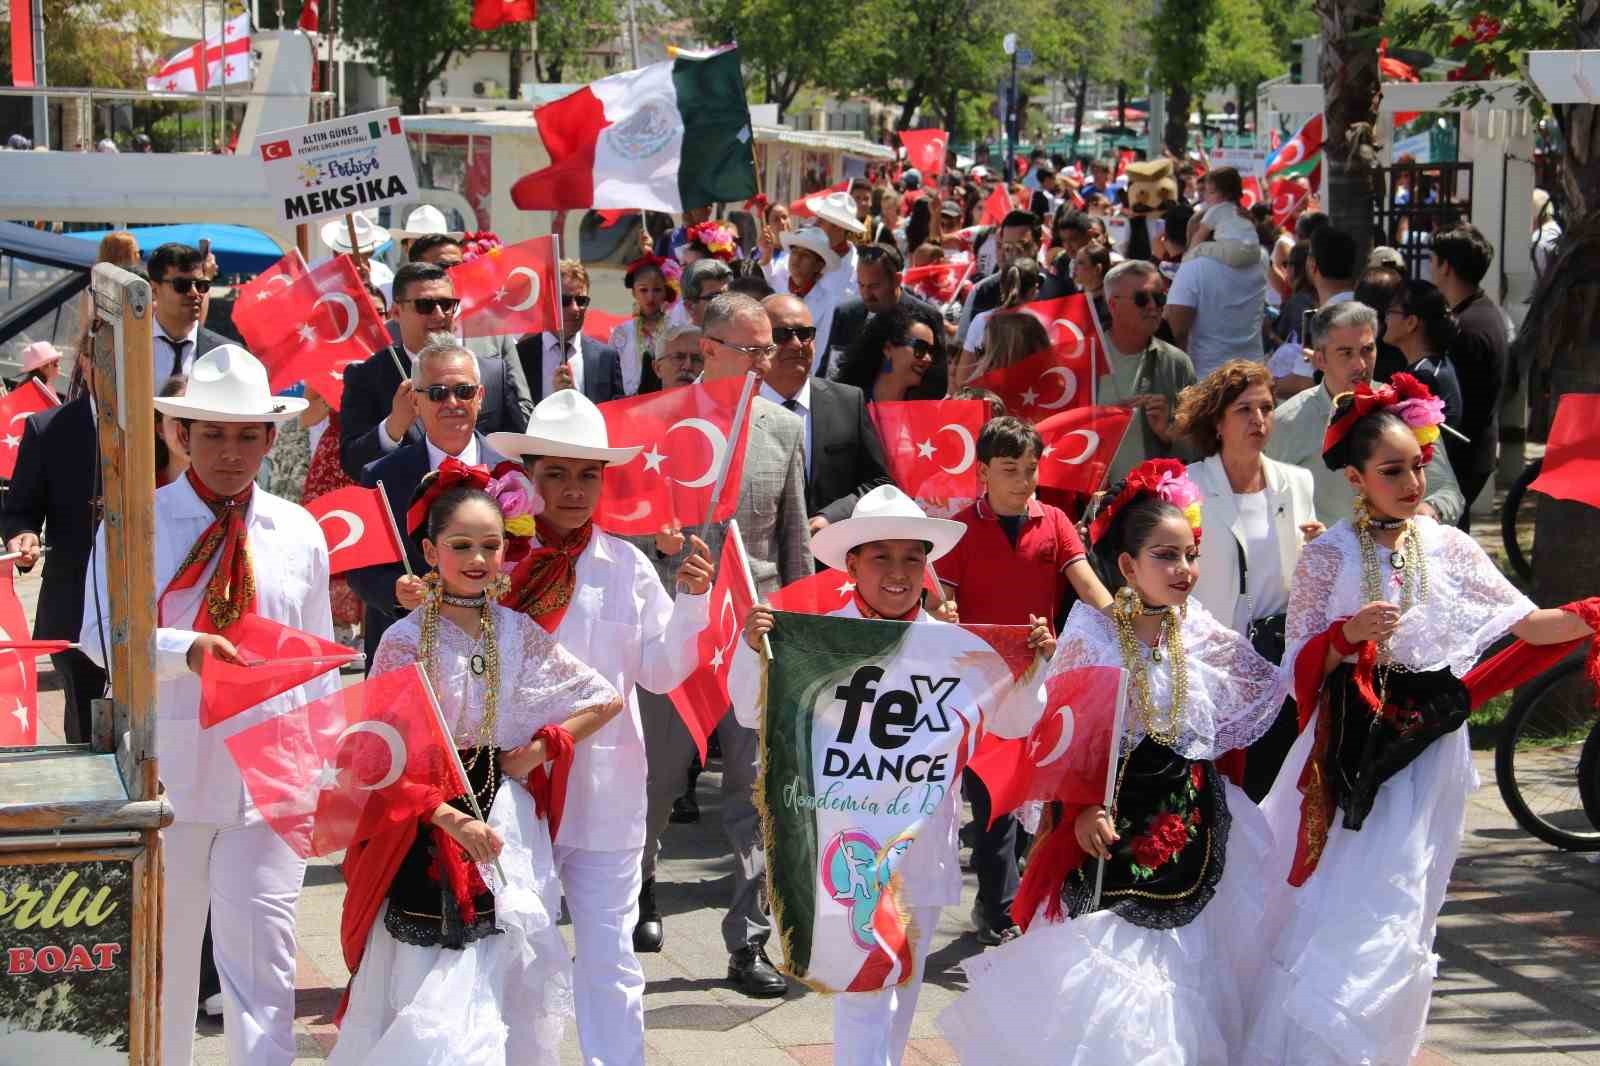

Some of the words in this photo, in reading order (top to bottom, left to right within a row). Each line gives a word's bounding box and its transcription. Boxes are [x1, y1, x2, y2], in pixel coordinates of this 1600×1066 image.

[284, 175, 408, 220] MEKSİKA
[822, 747, 949, 783] DANCE
[886, 785, 914, 815] de
[7, 942, 122, 975] BOAT
